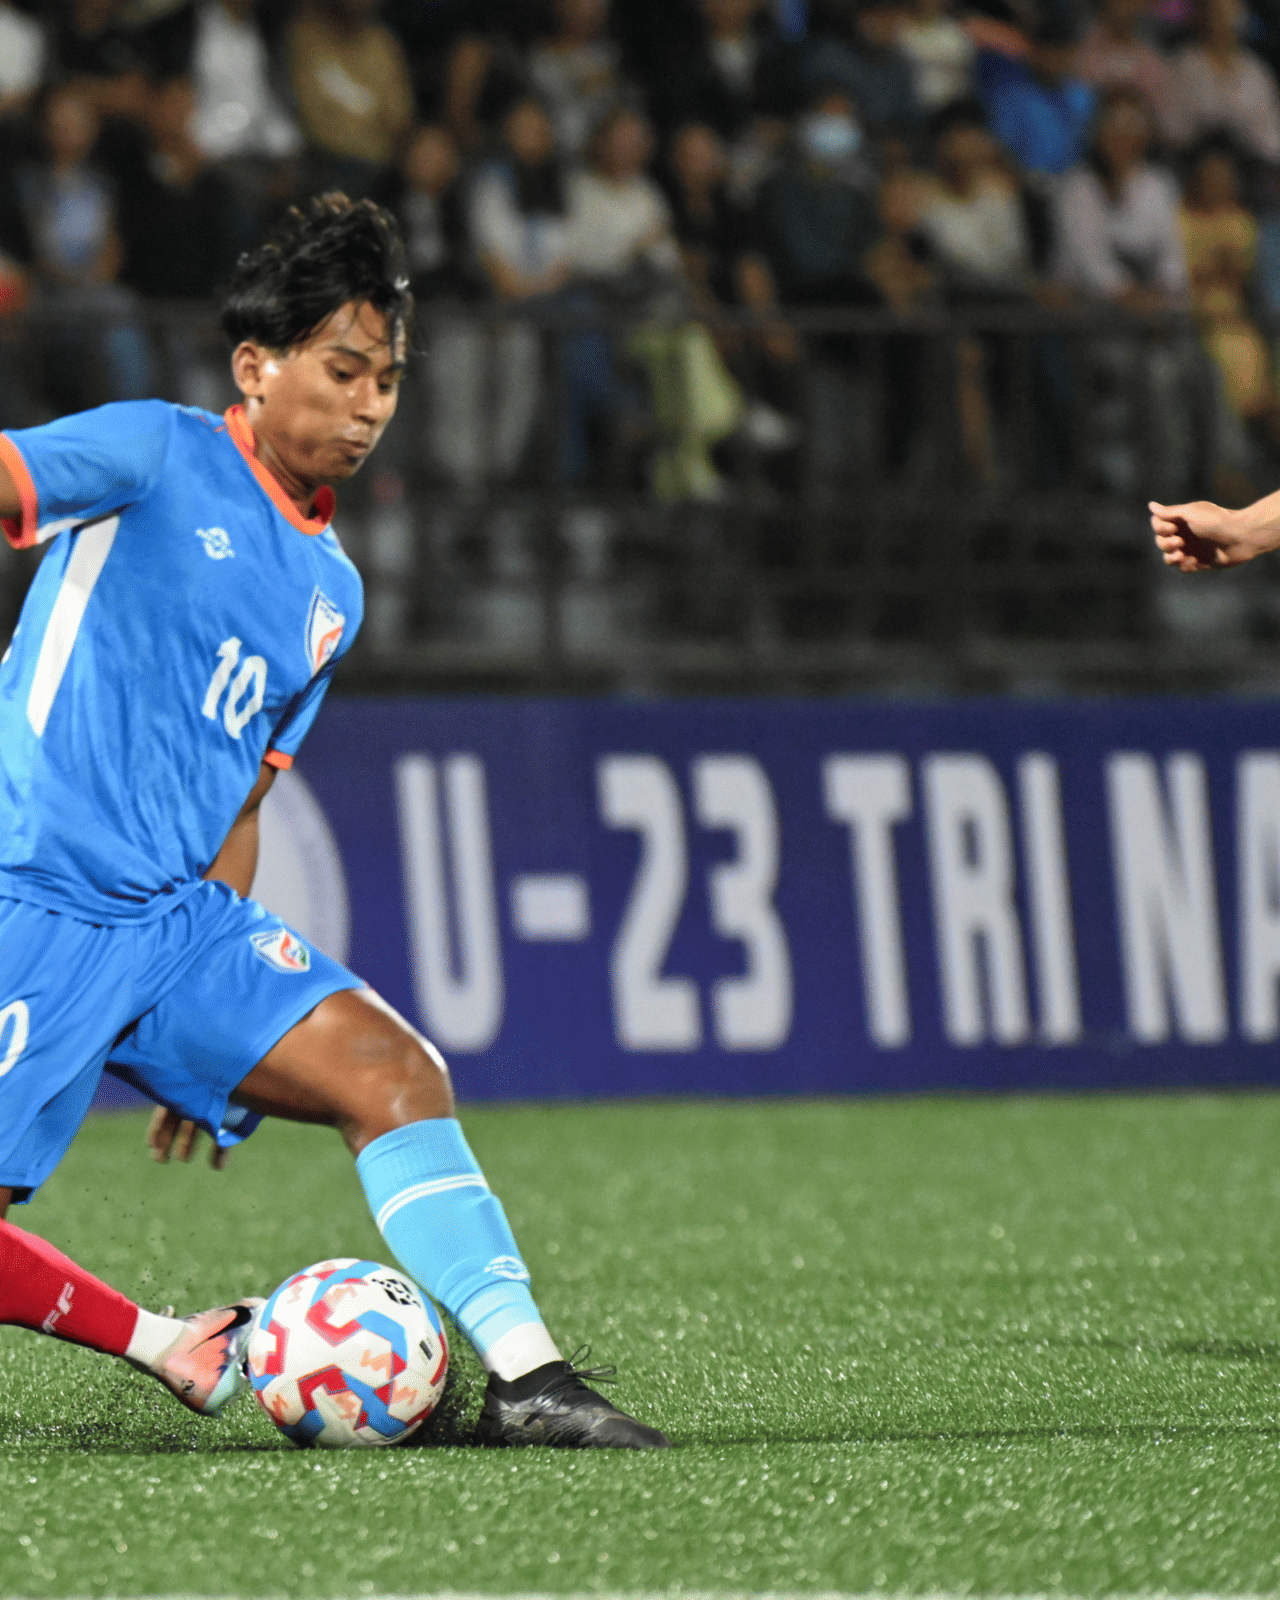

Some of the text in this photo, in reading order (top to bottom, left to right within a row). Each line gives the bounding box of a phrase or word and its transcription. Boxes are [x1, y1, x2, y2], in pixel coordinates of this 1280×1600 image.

[202, 636, 268, 739] 10
[395, 753, 793, 1052] U-23
[822, 752, 1082, 1047] TRI
